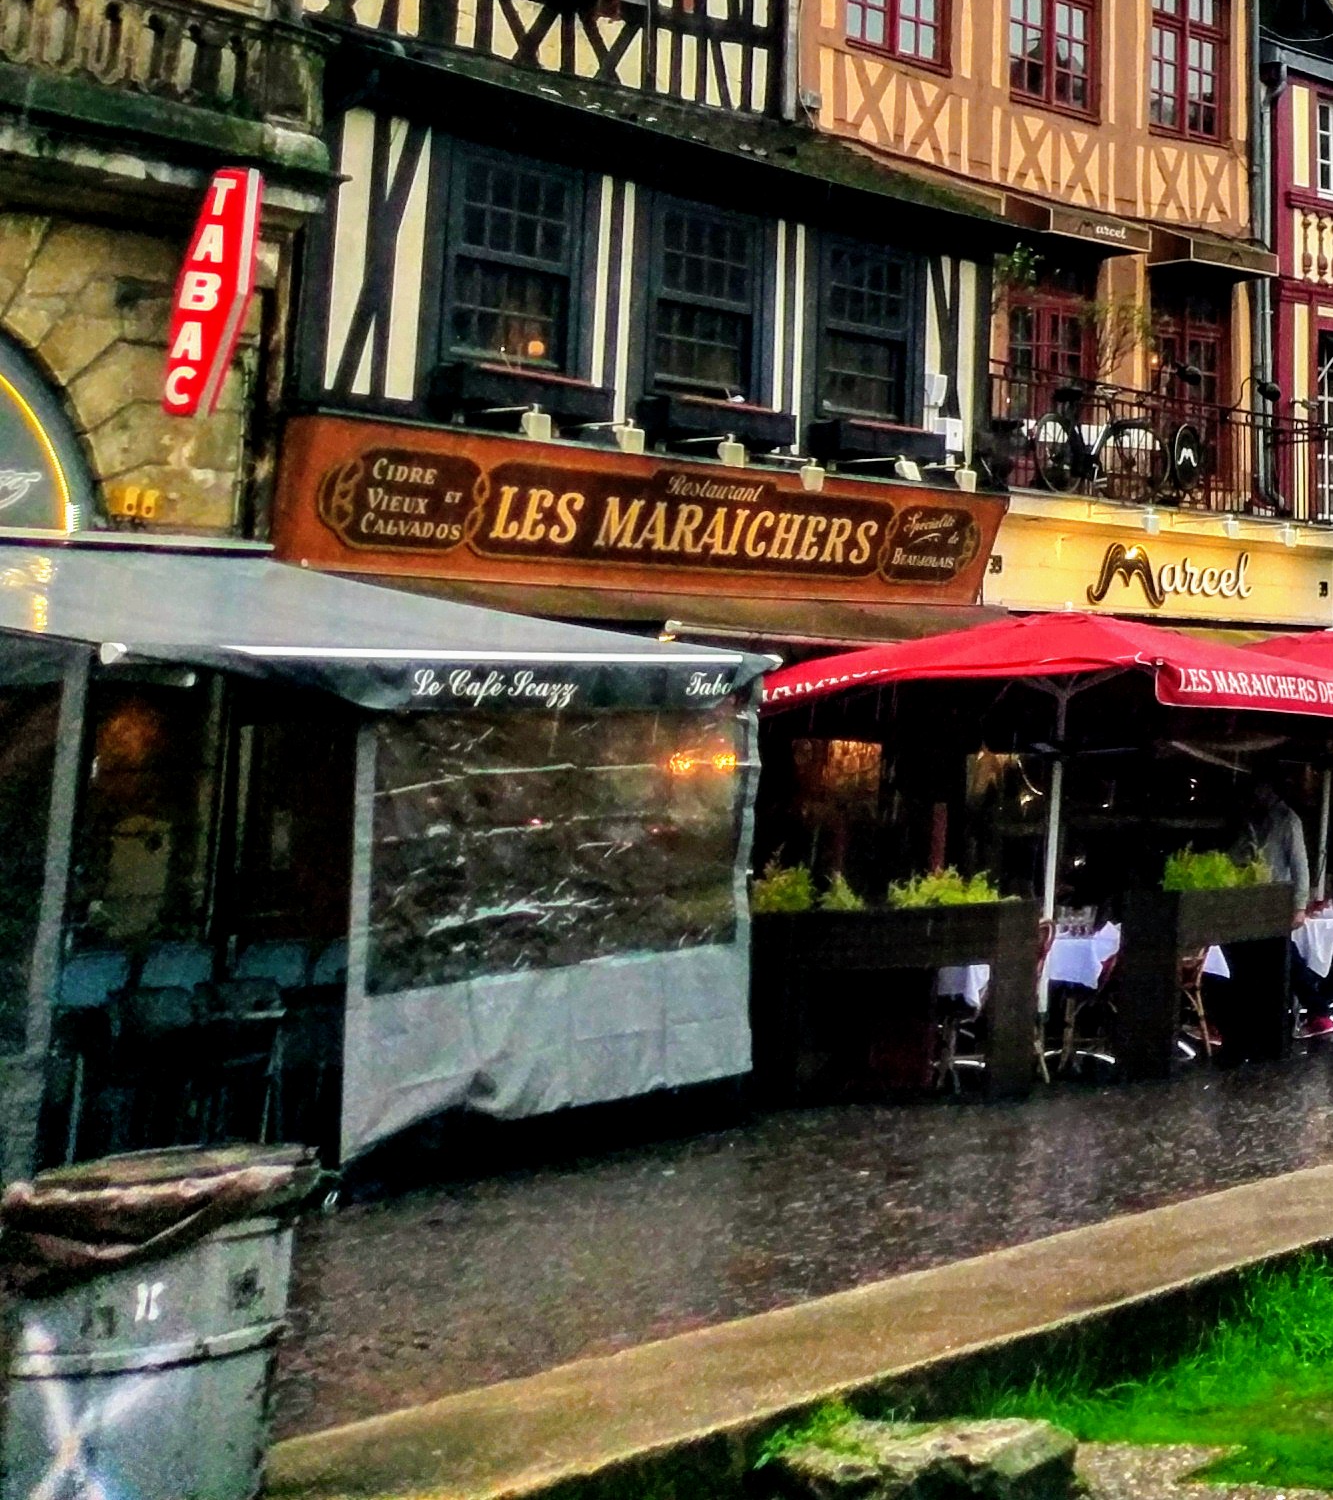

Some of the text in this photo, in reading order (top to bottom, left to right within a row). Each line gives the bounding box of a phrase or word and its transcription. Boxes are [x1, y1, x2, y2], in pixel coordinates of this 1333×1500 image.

[165, 177, 236, 406] TABAC
[666, 474, 765, 502] Restaurant
[489, 485, 879, 565] LES MARAICHERS
[1087, 542, 1252, 609] Marcel
[412, 669, 445, 696] Le
[450, 669, 507, 707] Café
[1178, 667, 1213, 693] LES
[1211, 670, 1319, 703] MARAICHERS
